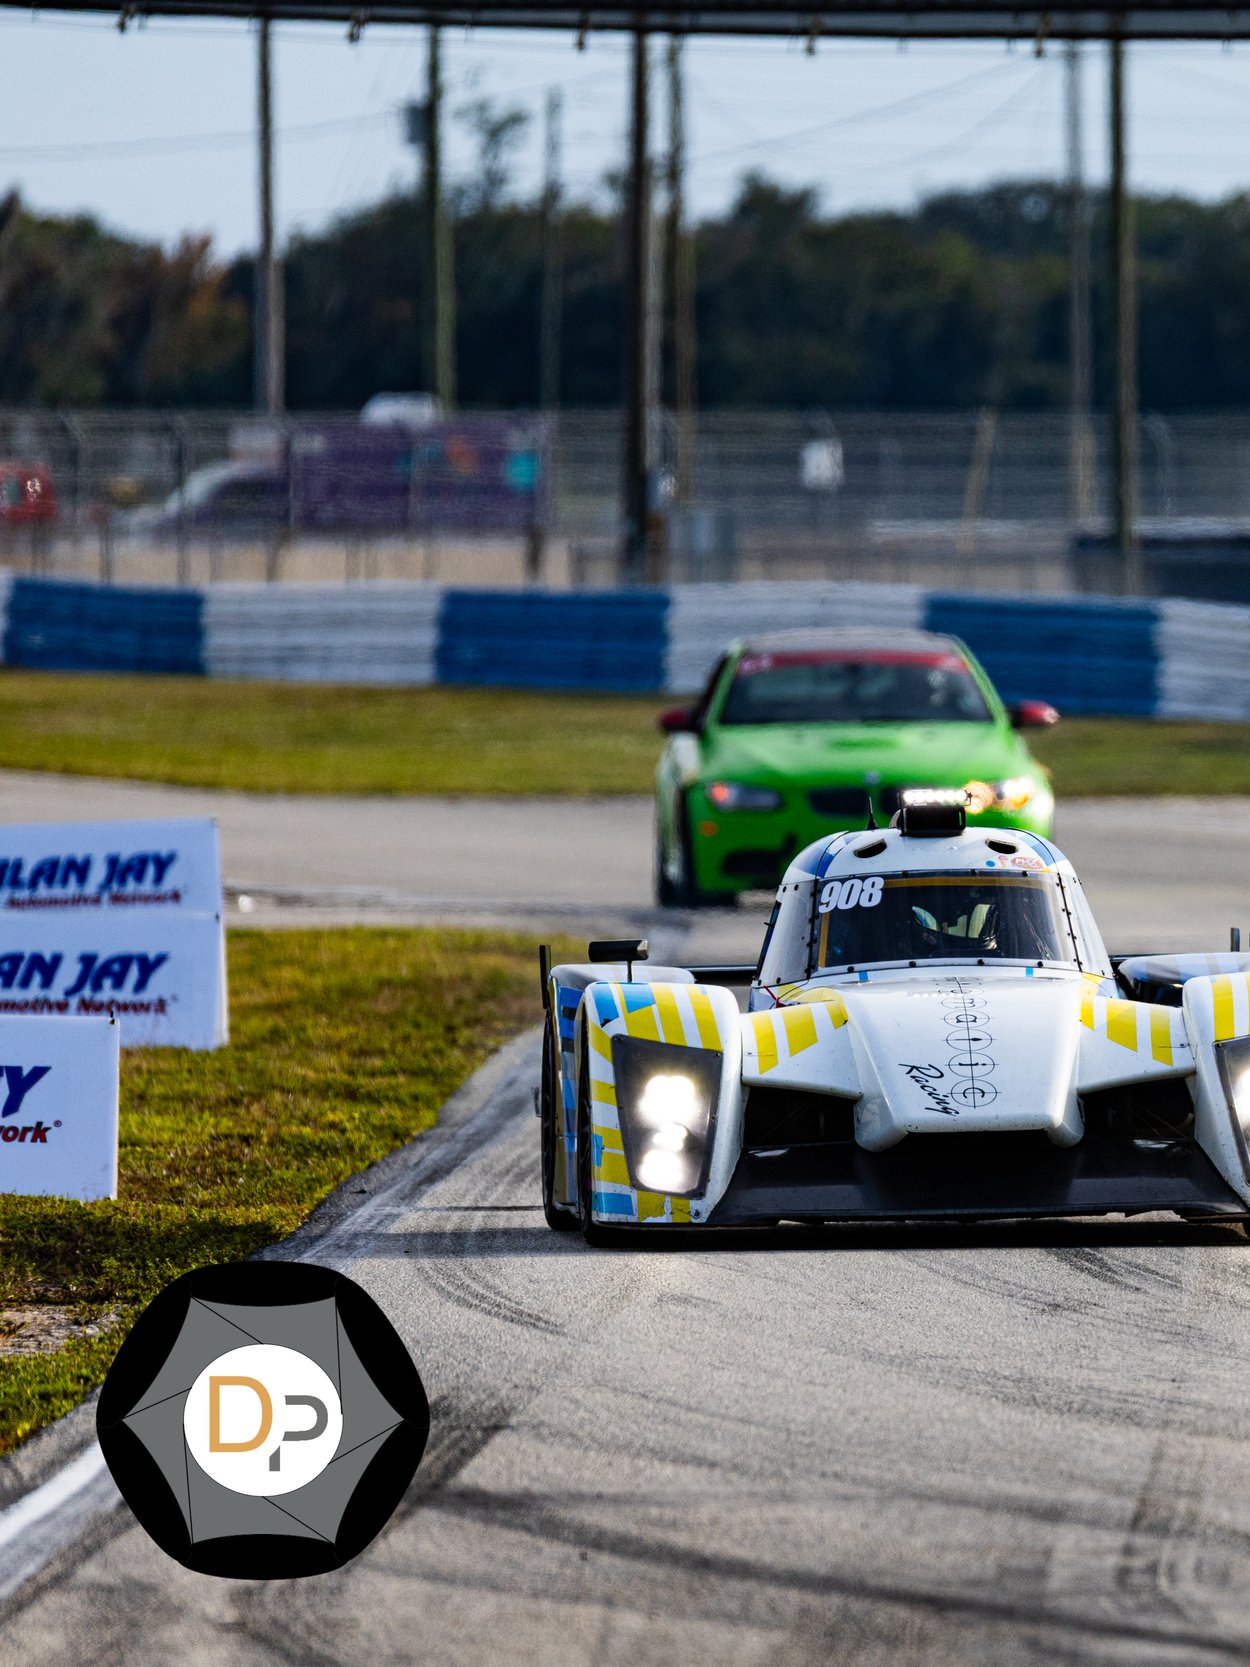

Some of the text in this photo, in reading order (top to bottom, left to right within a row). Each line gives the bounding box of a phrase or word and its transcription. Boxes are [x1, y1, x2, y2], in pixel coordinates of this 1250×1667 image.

[97, 849, 177, 894] JAY
[818, 876, 885, 914] 908
[64, 952, 170, 997] JAY
[898, 1063, 960, 1117] Racing
